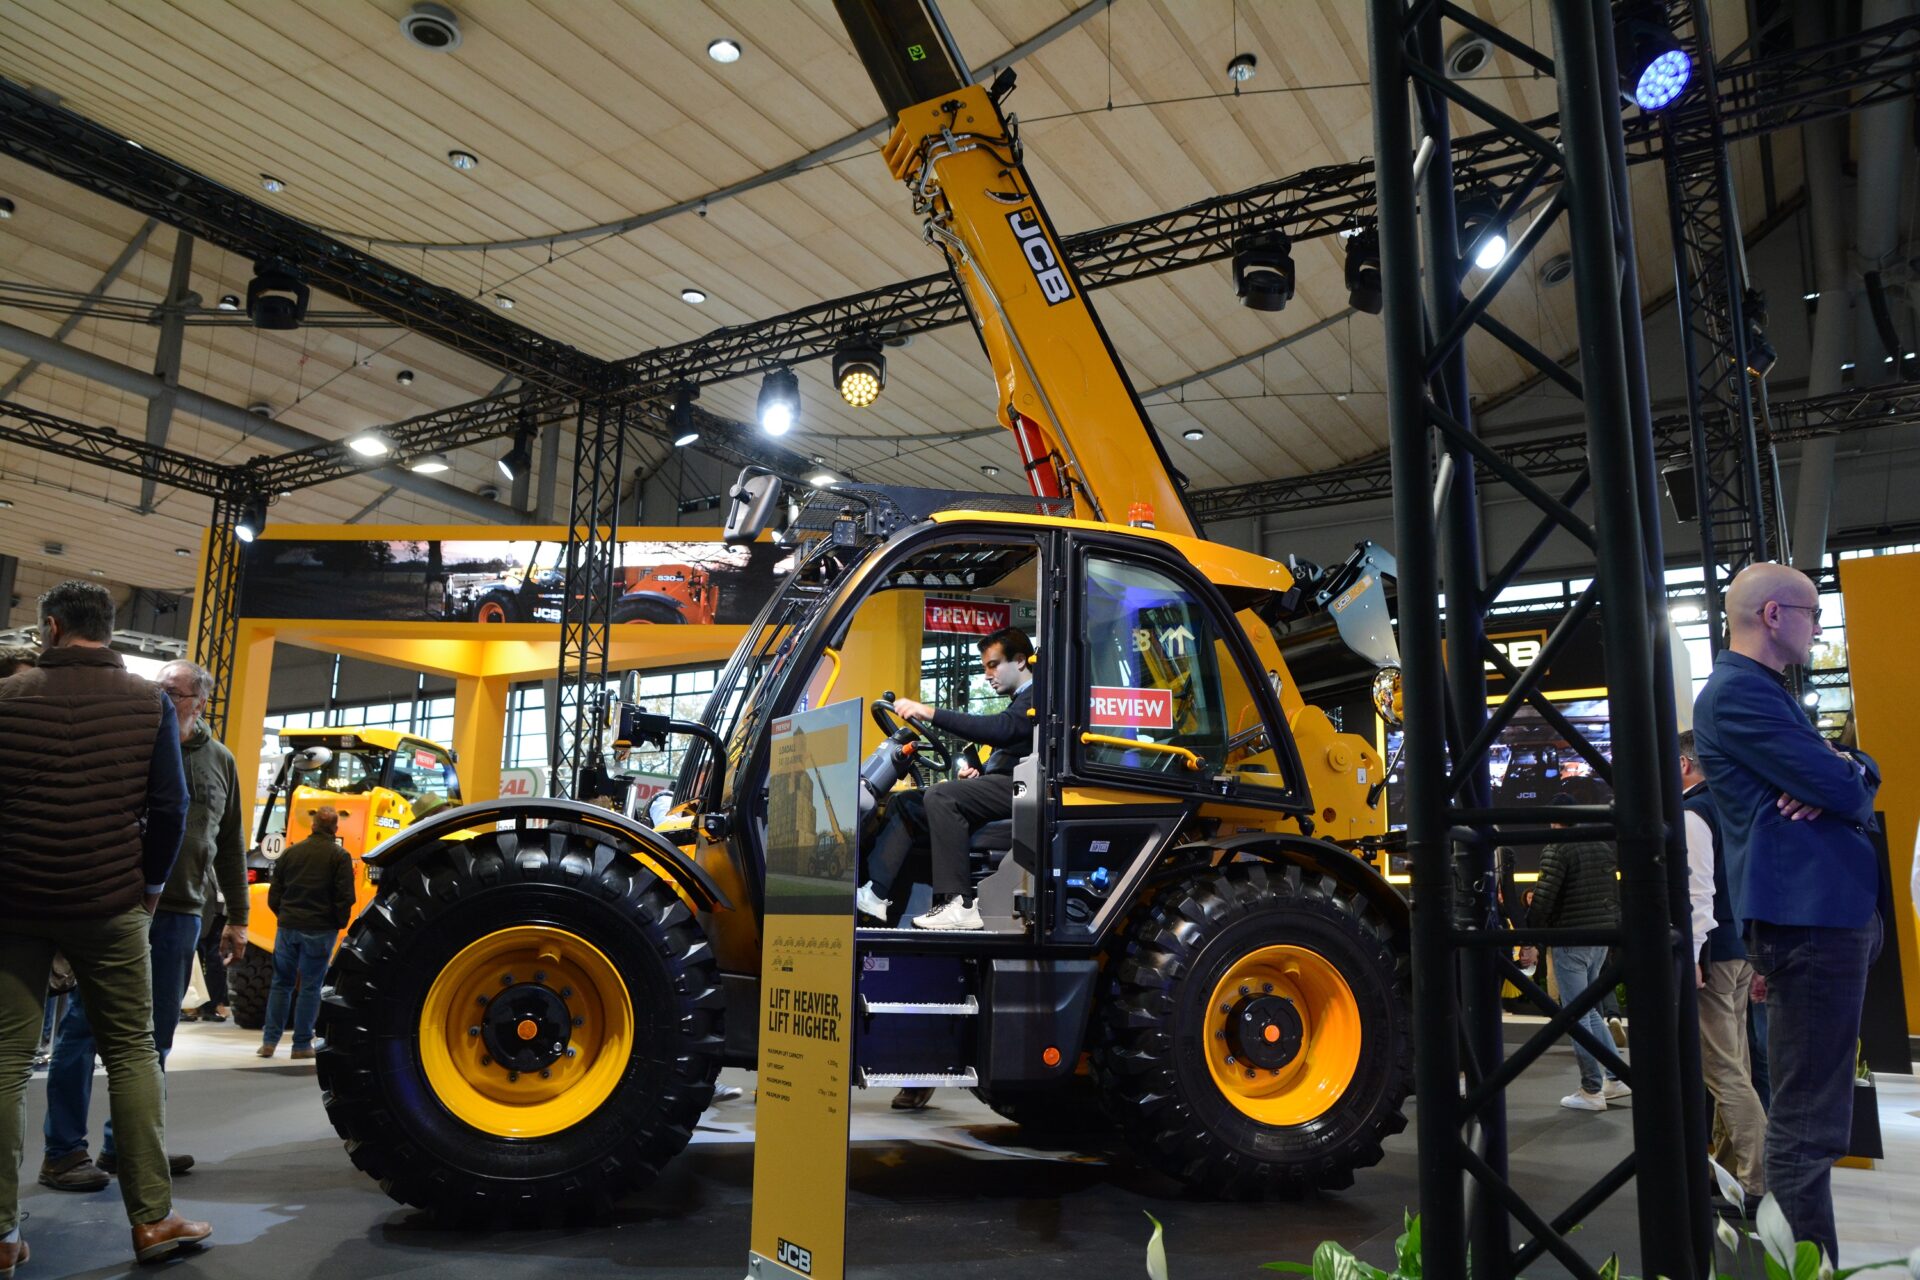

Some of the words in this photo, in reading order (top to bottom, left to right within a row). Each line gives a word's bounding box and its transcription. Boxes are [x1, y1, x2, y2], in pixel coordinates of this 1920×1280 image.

[1009, 213, 1071, 303] JCB
[533, 607, 562, 620] JCB
[932, 606, 1004, 628] PREVIEW
[1516, 791, 1537, 799] JCB
[267, 838, 280, 853] 40
[769, 987, 791, 1010] LIFT
[793, 989, 842, 1021] HEAVIER,
[768, 1010, 790, 1034] LIFT
[792, 1014, 840, 1043] HIGHER.
[778, 1241, 811, 1273] JCB
